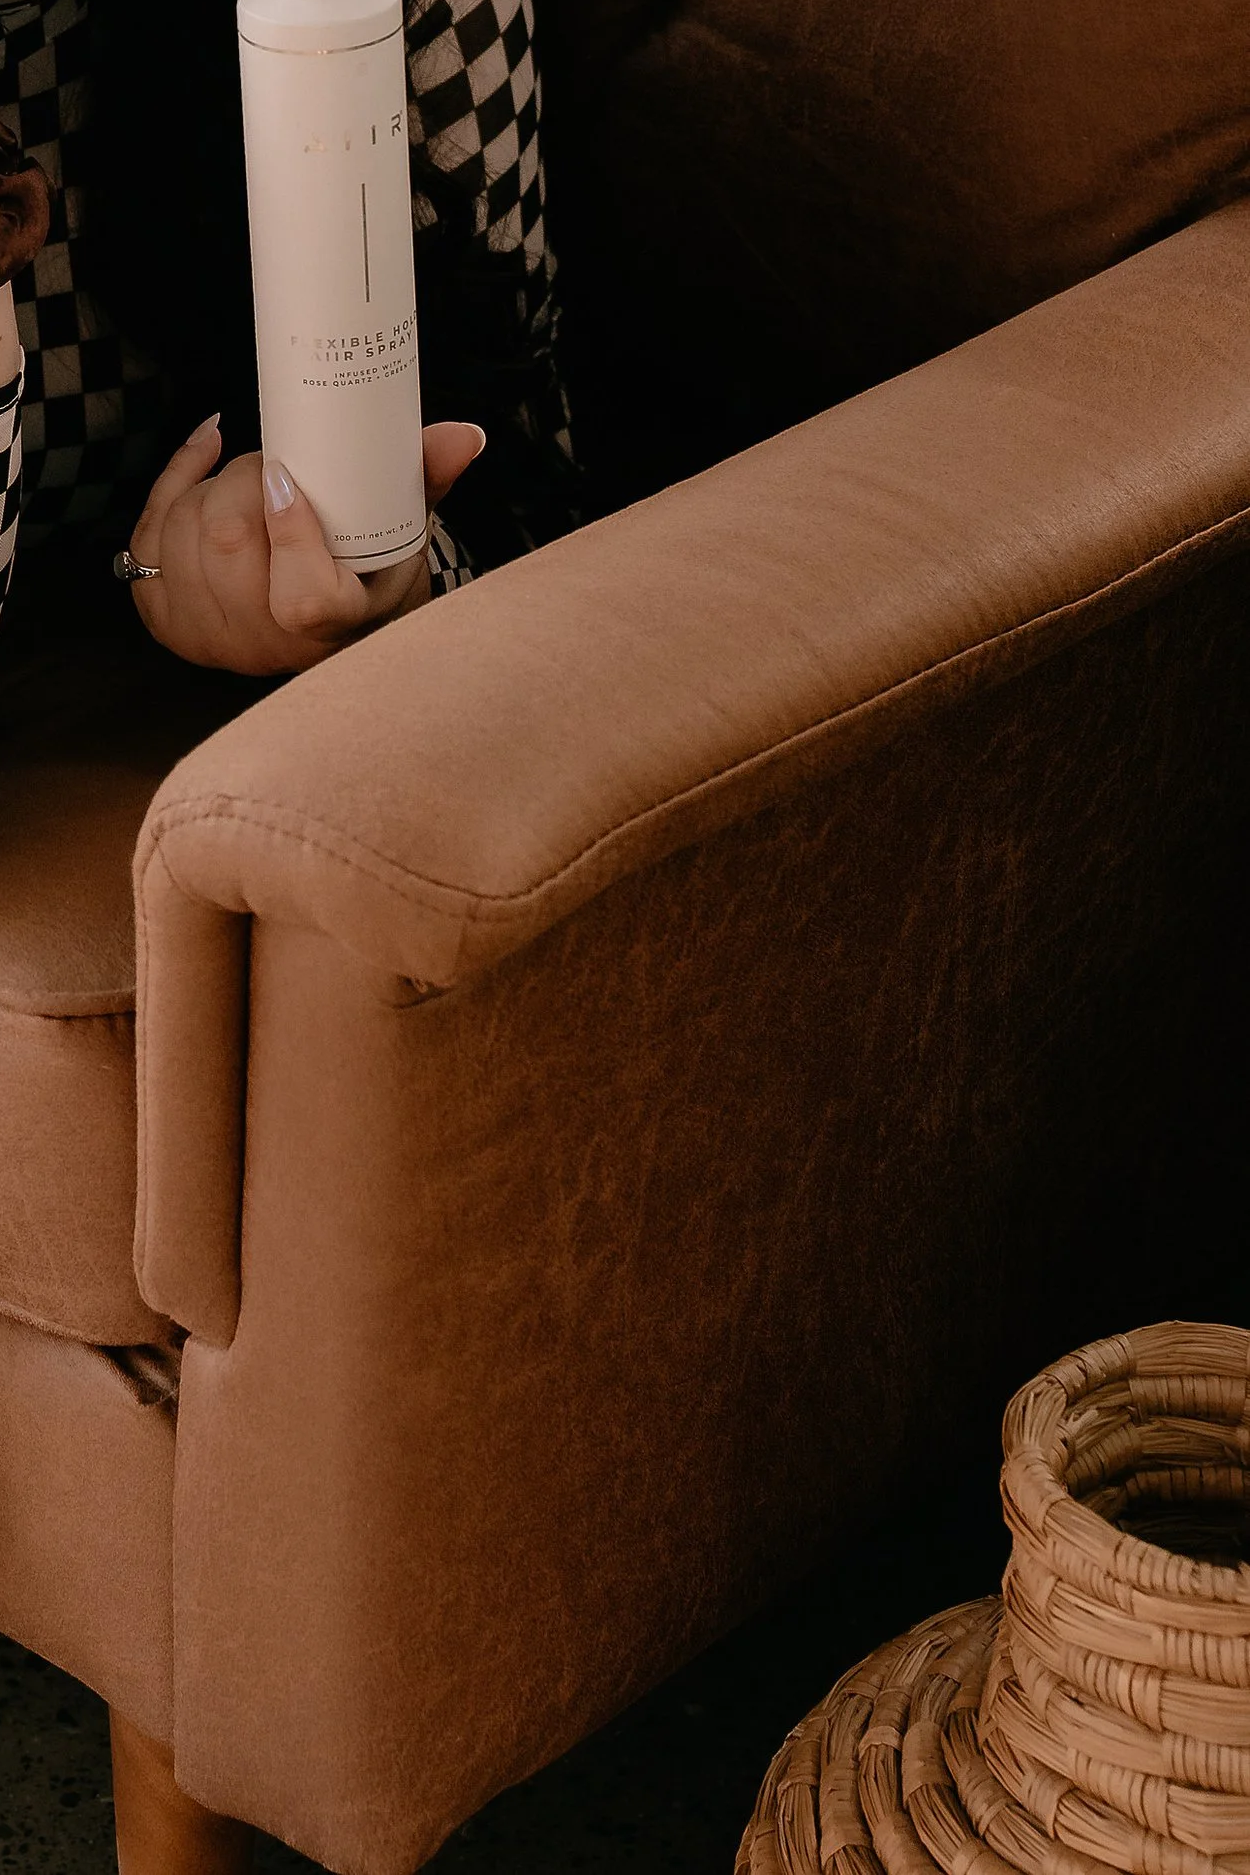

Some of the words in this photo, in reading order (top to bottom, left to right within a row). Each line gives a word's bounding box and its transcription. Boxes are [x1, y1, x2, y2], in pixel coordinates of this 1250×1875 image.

[291, 330, 384, 350] FEXIBLE
[365, 330, 412, 358] SPRAY
[302, 379, 328, 387] ROSE
[332, 376, 373, 388] QUARTZ
[384, 362, 408, 378] GREEN
[334, 367, 378, 379] INFUSED
[381, 358, 402, 371] WITH
[334, 534, 351, 542] 300
[354, 533, 366, 541] ml
[369, 531, 383, 539] net
[385, 527, 398, 535] wt.
